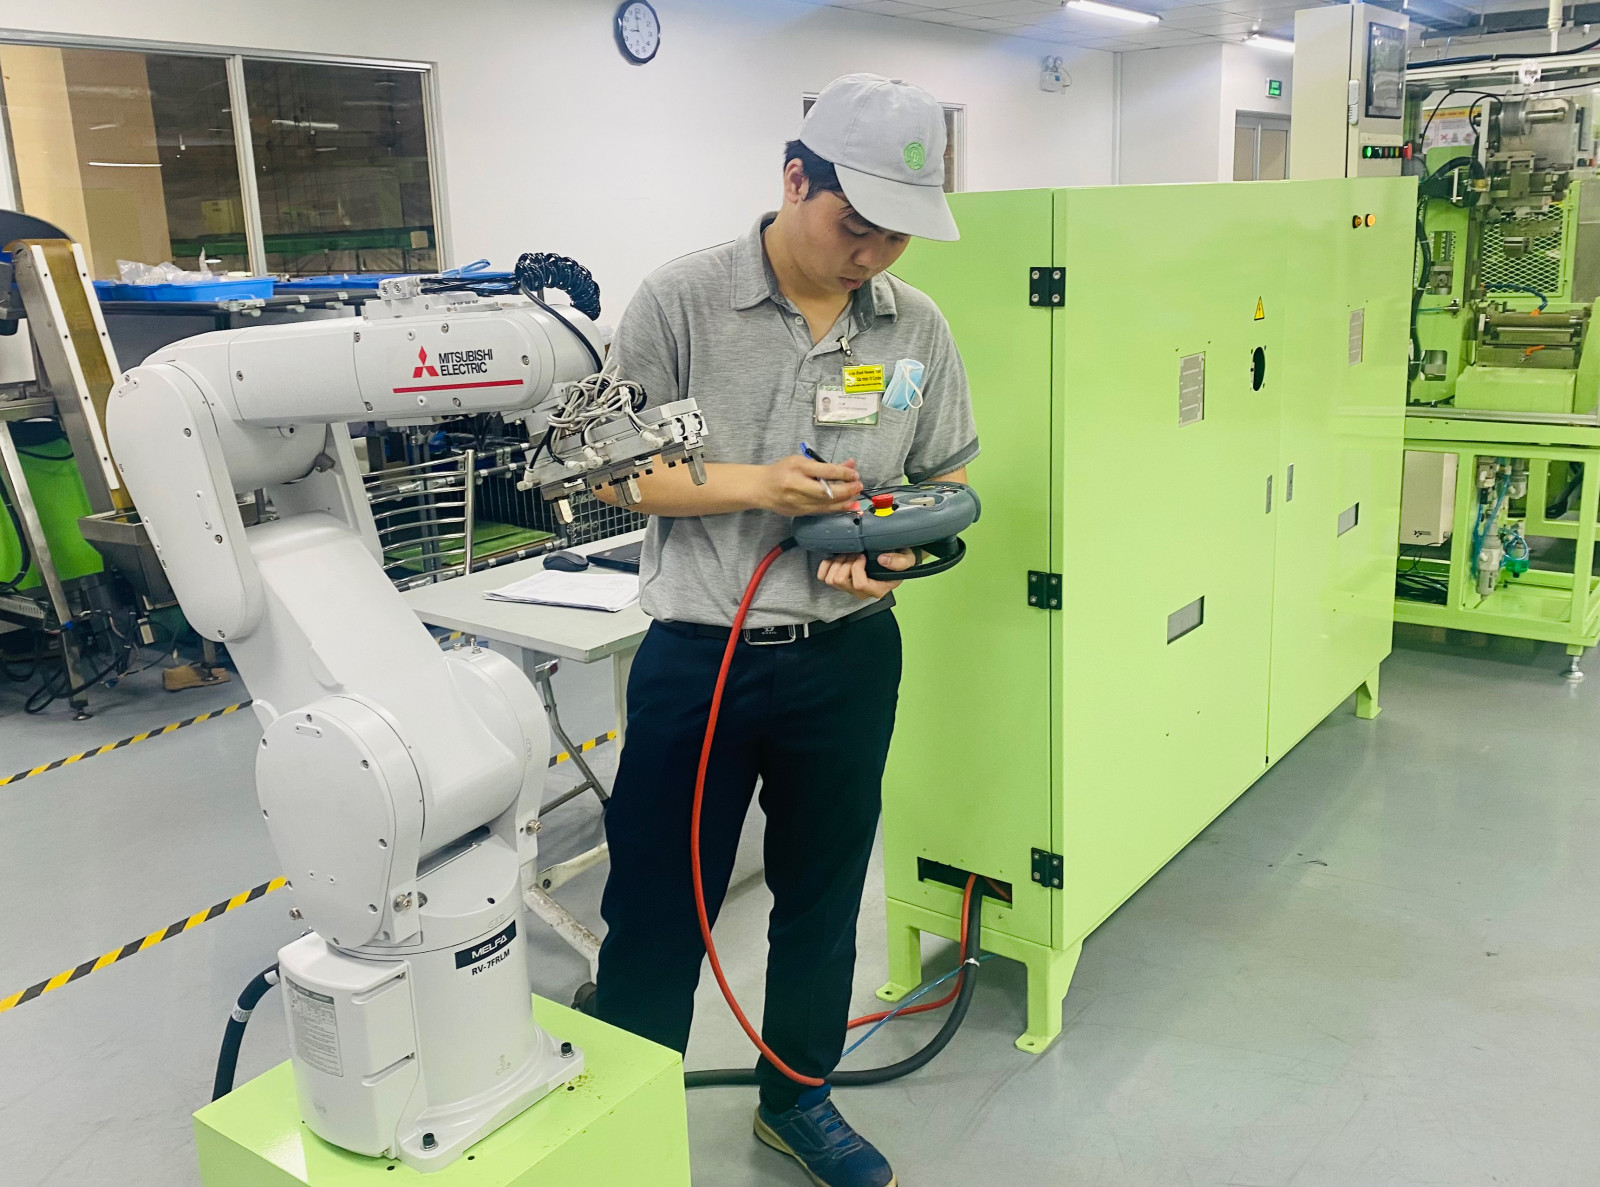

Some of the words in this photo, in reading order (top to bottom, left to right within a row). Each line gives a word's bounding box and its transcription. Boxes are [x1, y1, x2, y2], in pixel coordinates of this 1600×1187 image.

[438, 349, 493, 364] MITSUBISHI
[440, 362, 488, 376] ELECTRIC
[471, 934, 508, 959] MELFA
[471, 948, 510, 976] RV-7FRLM
